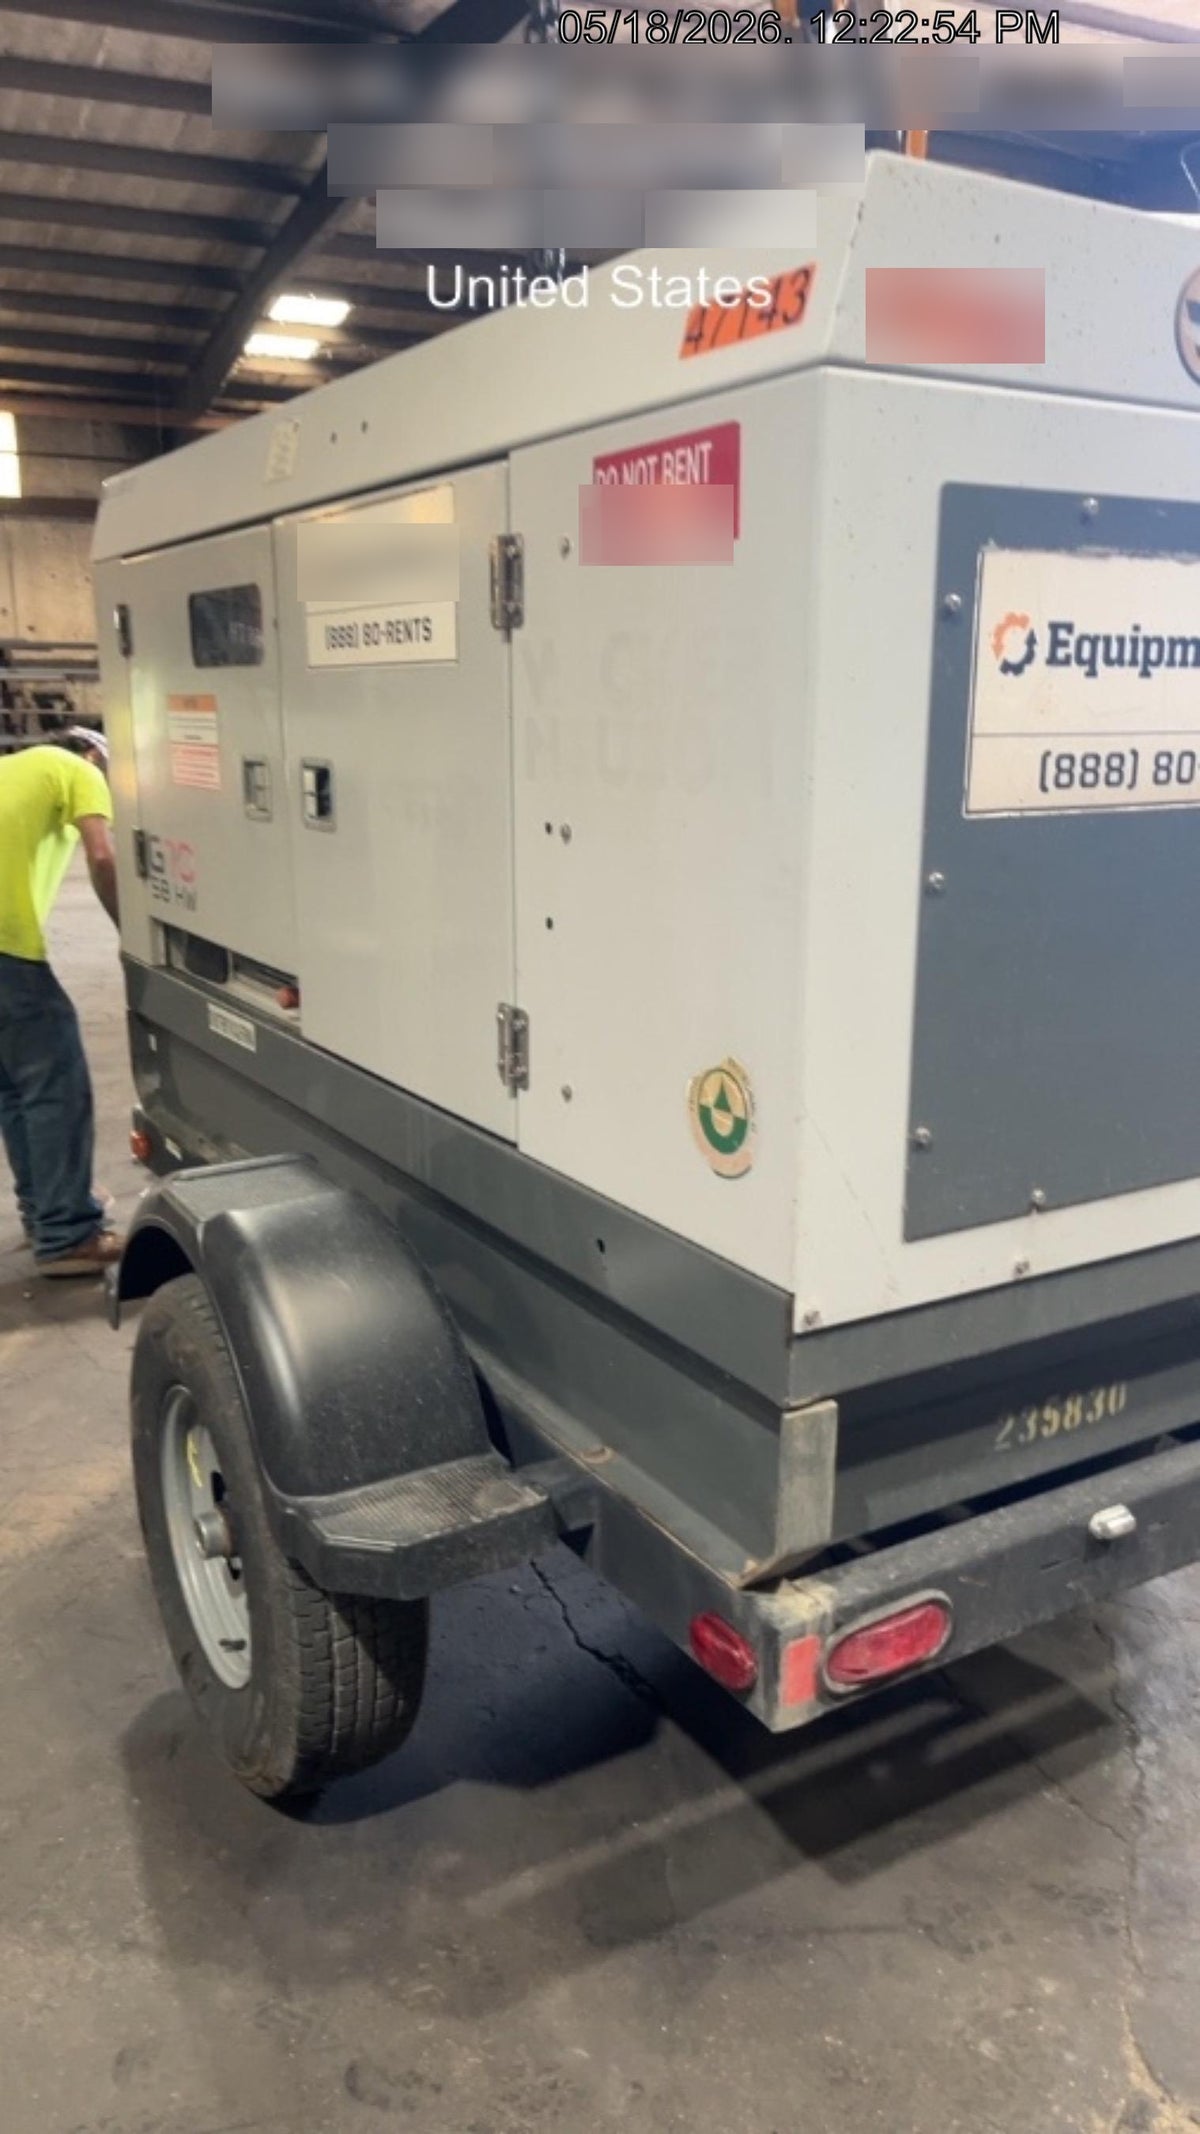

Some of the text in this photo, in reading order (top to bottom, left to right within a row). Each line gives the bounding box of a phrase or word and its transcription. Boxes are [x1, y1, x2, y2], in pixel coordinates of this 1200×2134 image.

[621, 454, 658, 485] NOT
[661, 441, 713, 485] RENT
[324, 615, 433, 651] (888) 80-RENTS
[1039, 748, 1200, 793] (888) 80
